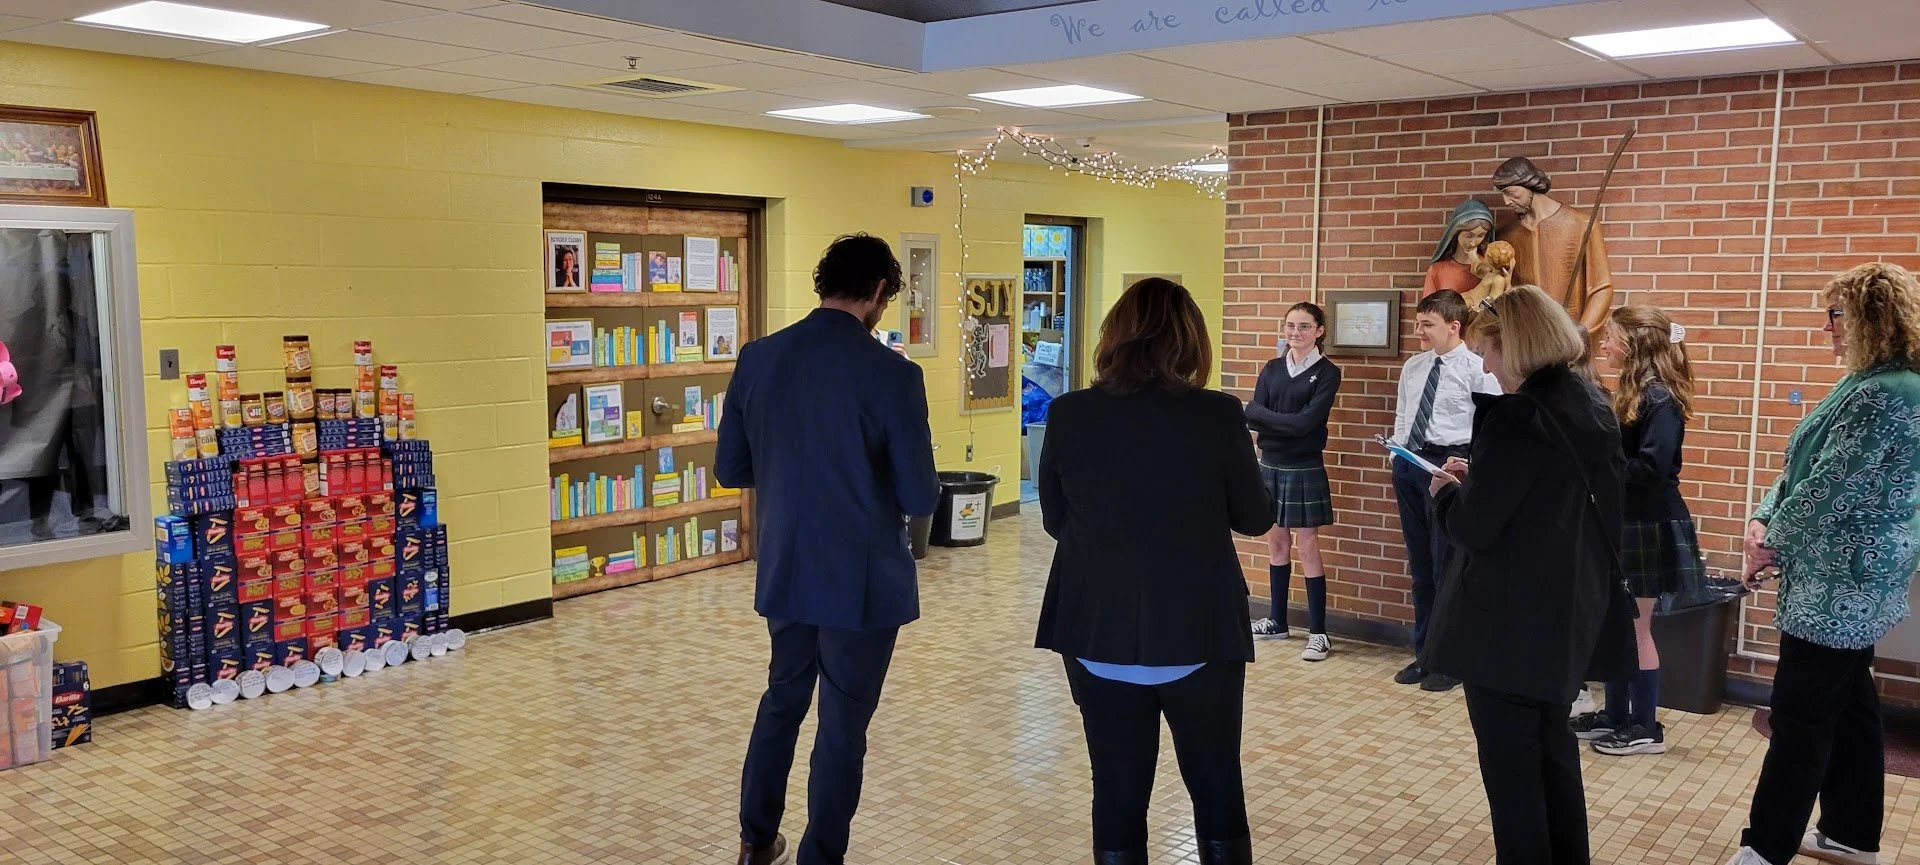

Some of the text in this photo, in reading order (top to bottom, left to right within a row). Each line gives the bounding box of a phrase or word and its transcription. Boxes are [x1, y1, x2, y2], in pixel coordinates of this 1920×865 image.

[1050, 13, 1105, 45] We
[1129, 10, 1182, 33] are
[966, 280, 1015, 317] SJY
[82, 681, 90, 691] 6
[55, 693, 81, 704] Barilla
